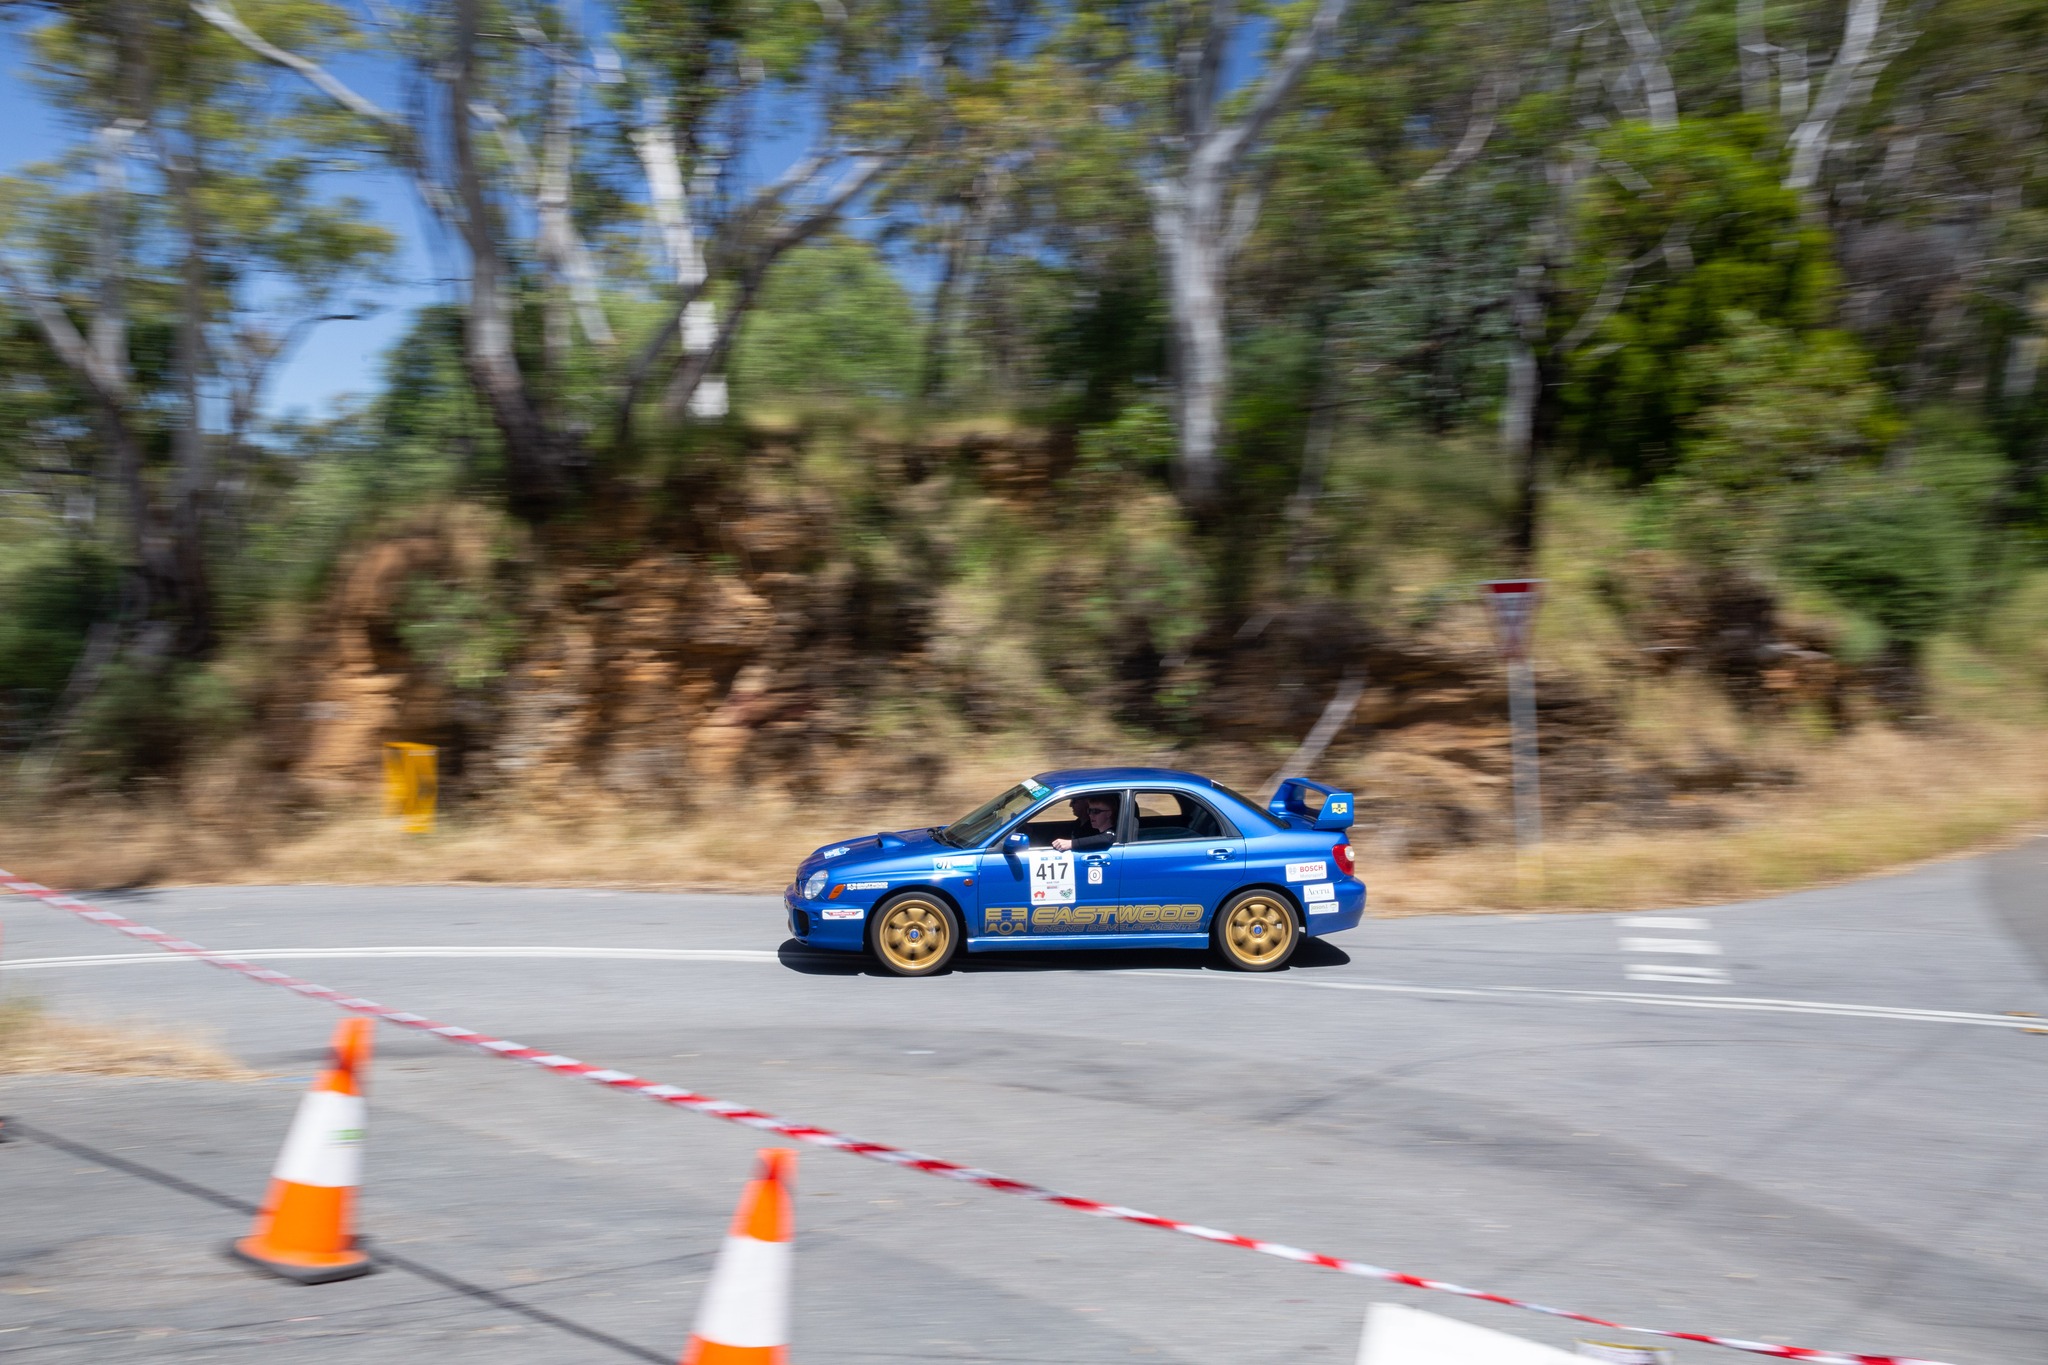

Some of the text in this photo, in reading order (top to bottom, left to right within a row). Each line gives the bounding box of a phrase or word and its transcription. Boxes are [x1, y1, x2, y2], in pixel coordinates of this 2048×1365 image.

[1036, 862, 1068, 880] 417
[1032, 904, 1204, 925] EASTWOOD
[1033, 922, 1201, 934] ENGINE DEVELOPMENTS
